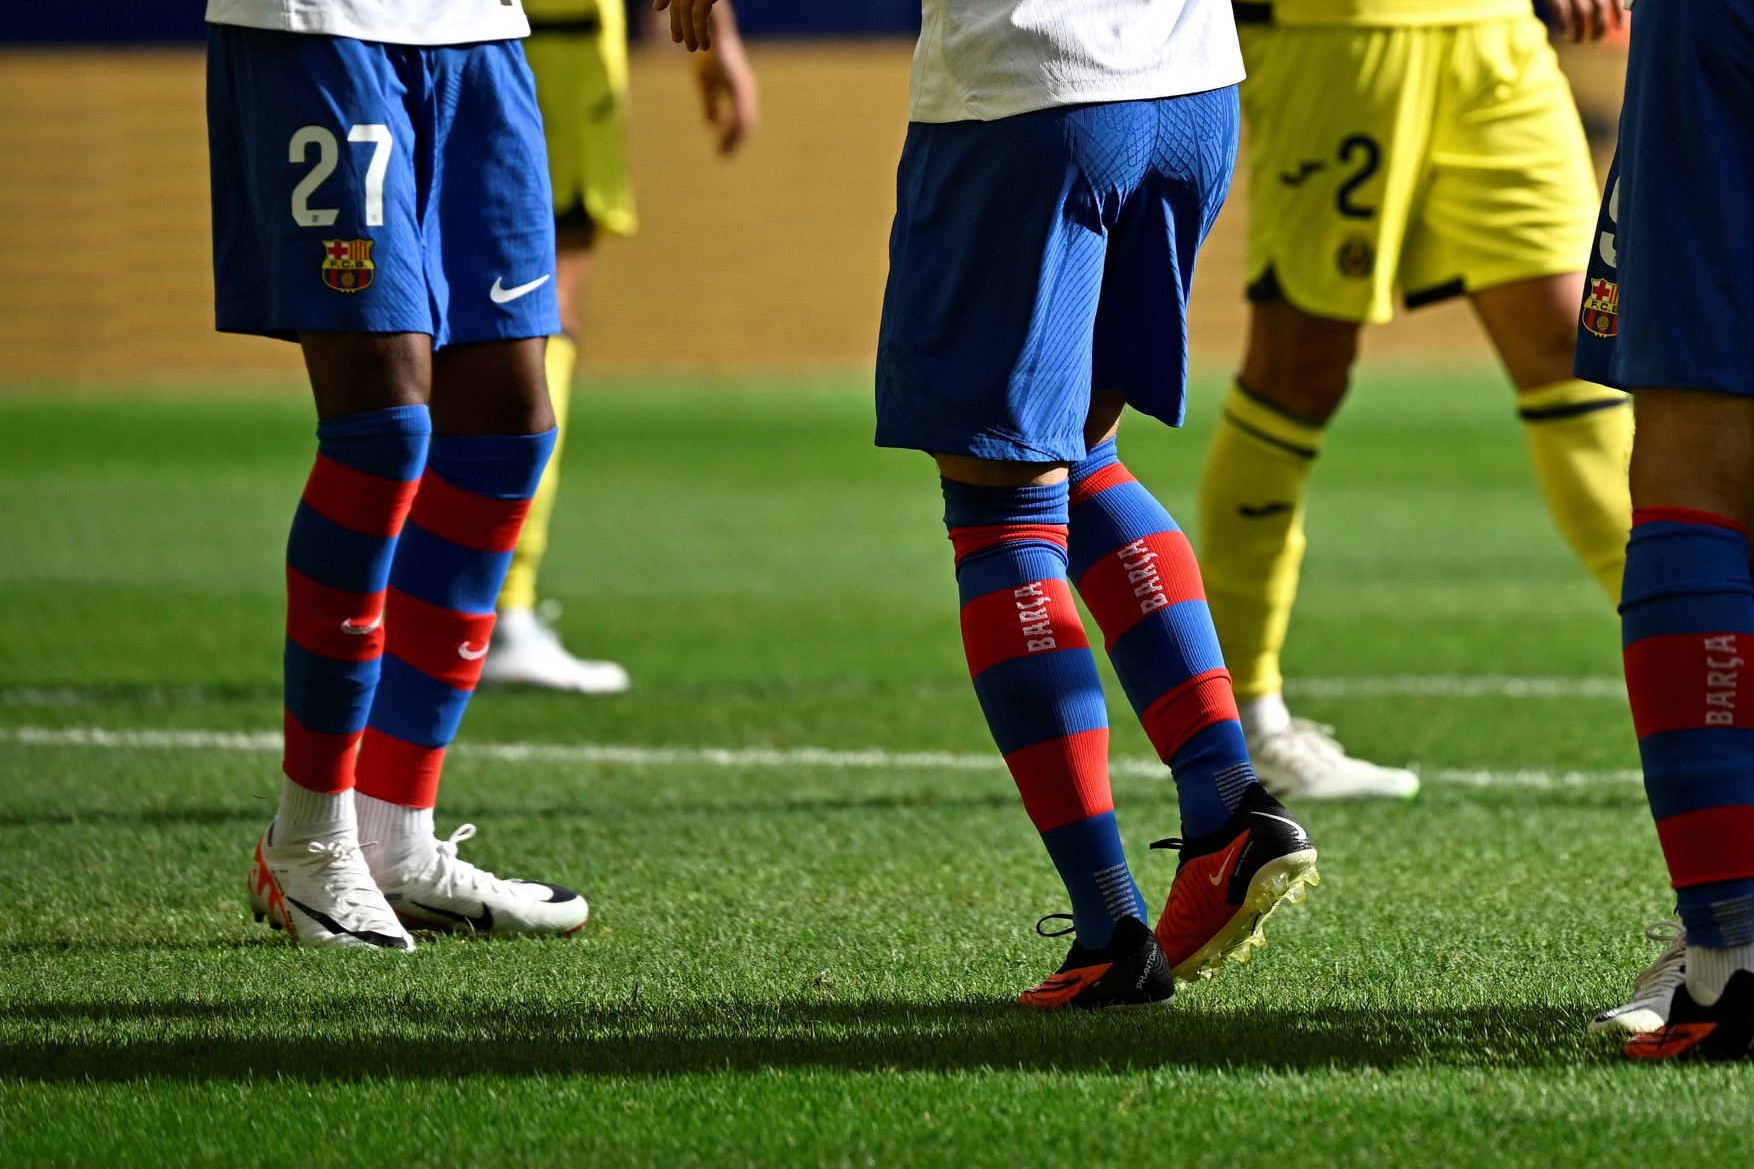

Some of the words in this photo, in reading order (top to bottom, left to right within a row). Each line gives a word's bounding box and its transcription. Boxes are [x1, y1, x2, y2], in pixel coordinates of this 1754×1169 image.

[288, 124, 394, 227] 27
[1336, 134, 1381, 220] 2
[329, 259, 368, 269] F.C.B.
[1590, 300, 1618, 313] F.C.B
[1117, 538, 1169, 615] BARÇA
[1014, 581, 1057, 653] BARÇA
[1705, 634, 1745, 726] BARÇA
